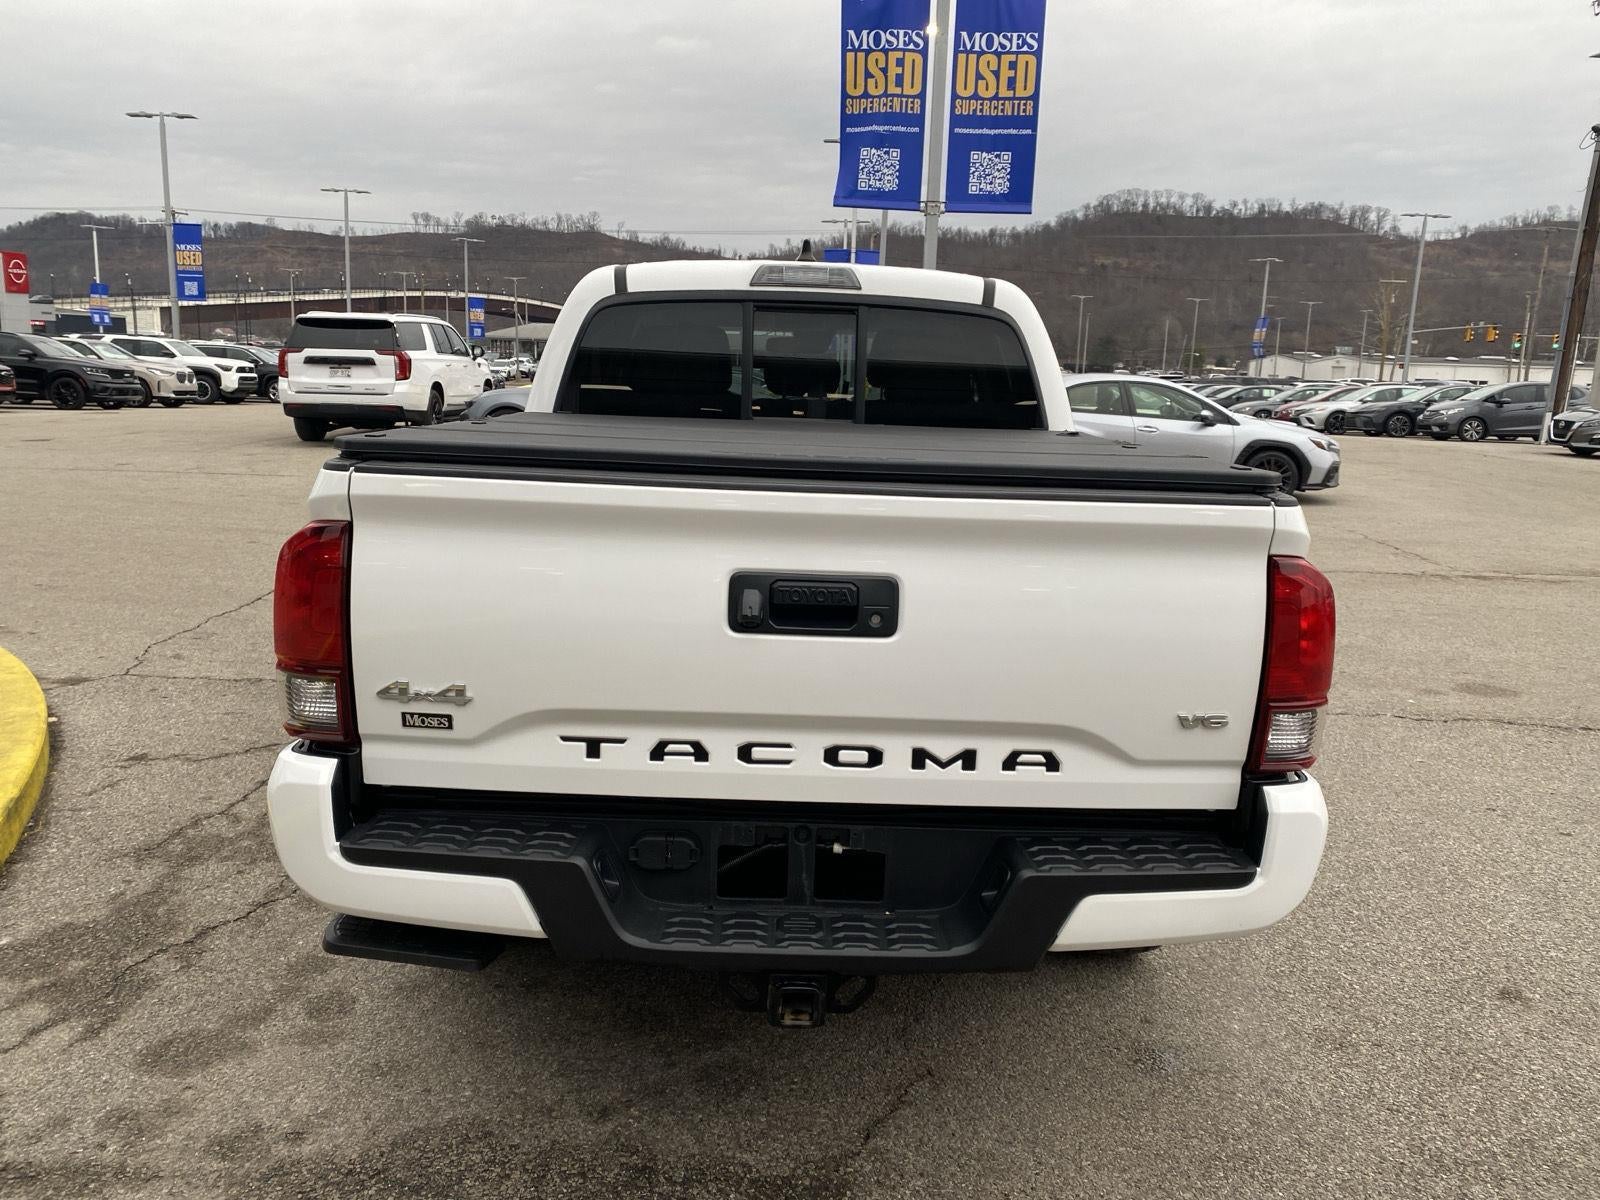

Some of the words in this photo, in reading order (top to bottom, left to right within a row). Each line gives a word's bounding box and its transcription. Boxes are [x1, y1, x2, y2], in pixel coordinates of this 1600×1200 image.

[846, 29, 925, 50] MOSES
[959, 31, 1039, 52] MOSES
[845, 51, 924, 96] USED
[955, 53, 1038, 98] USED
[845, 97, 921, 115] SUPERCENTER
[954, 99, 1034, 116] SUPERCENTER
[845, 124, 920, 134] mosesusedsupercenter.com
[954, 127, 1032, 136] mosesusedsupercenter.com
[176, 250, 203, 266] USED
[776, 586, 857, 604] TOYOTA
[376, 680, 474, 706] 4x4
[1177, 713, 1229, 729] V6
[558, 734, 1062, 774] TACOMA
